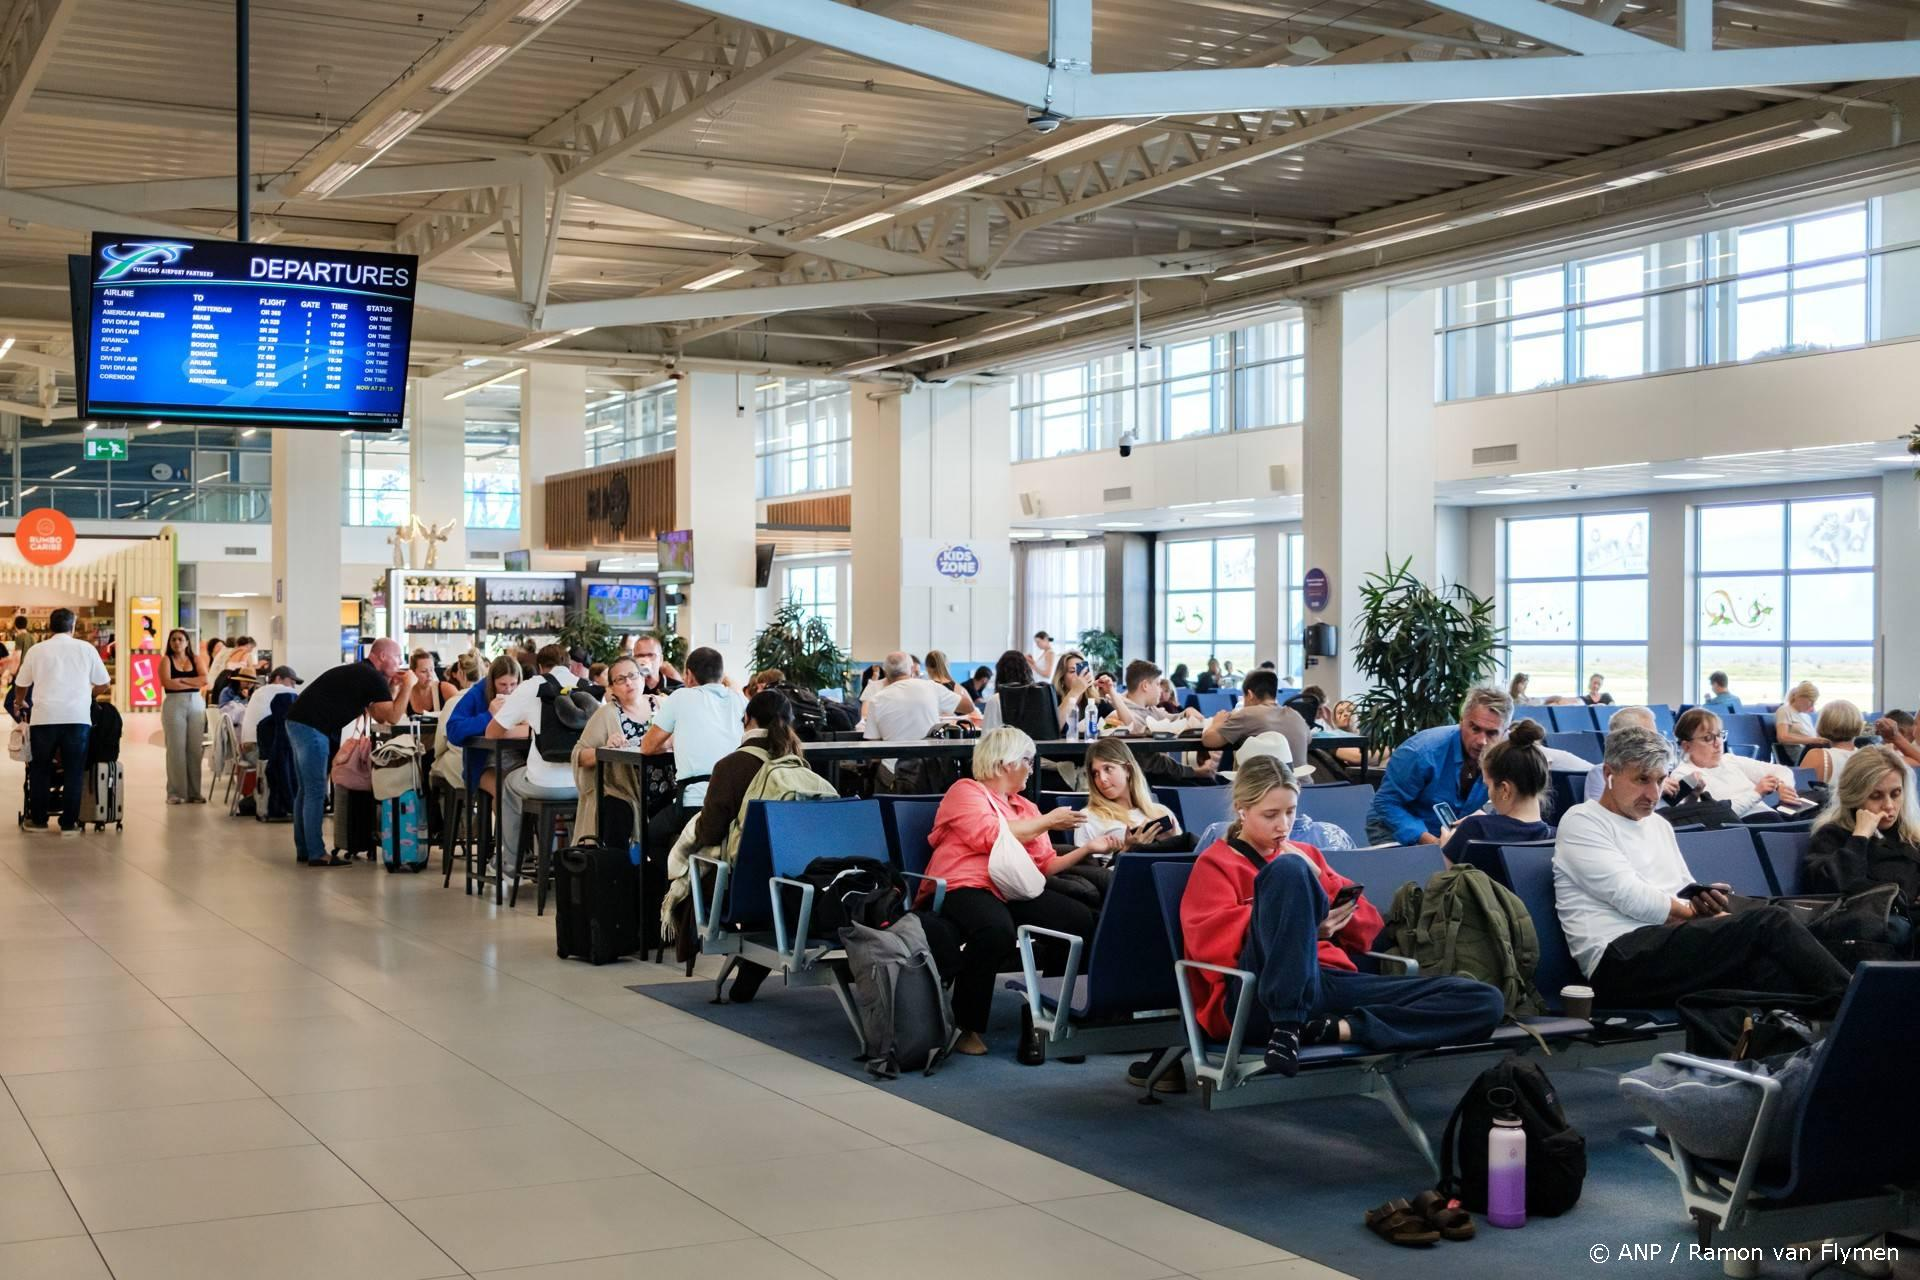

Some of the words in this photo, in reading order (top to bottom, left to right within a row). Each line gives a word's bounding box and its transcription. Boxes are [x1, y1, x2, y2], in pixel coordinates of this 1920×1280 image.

[250, 257, 409, 287] DEPARTURES
[103, 289, 134, 297] AIRLINE
[944, 551, 972, 561] KIDS
[940, 562, 976, 573] ZONE
